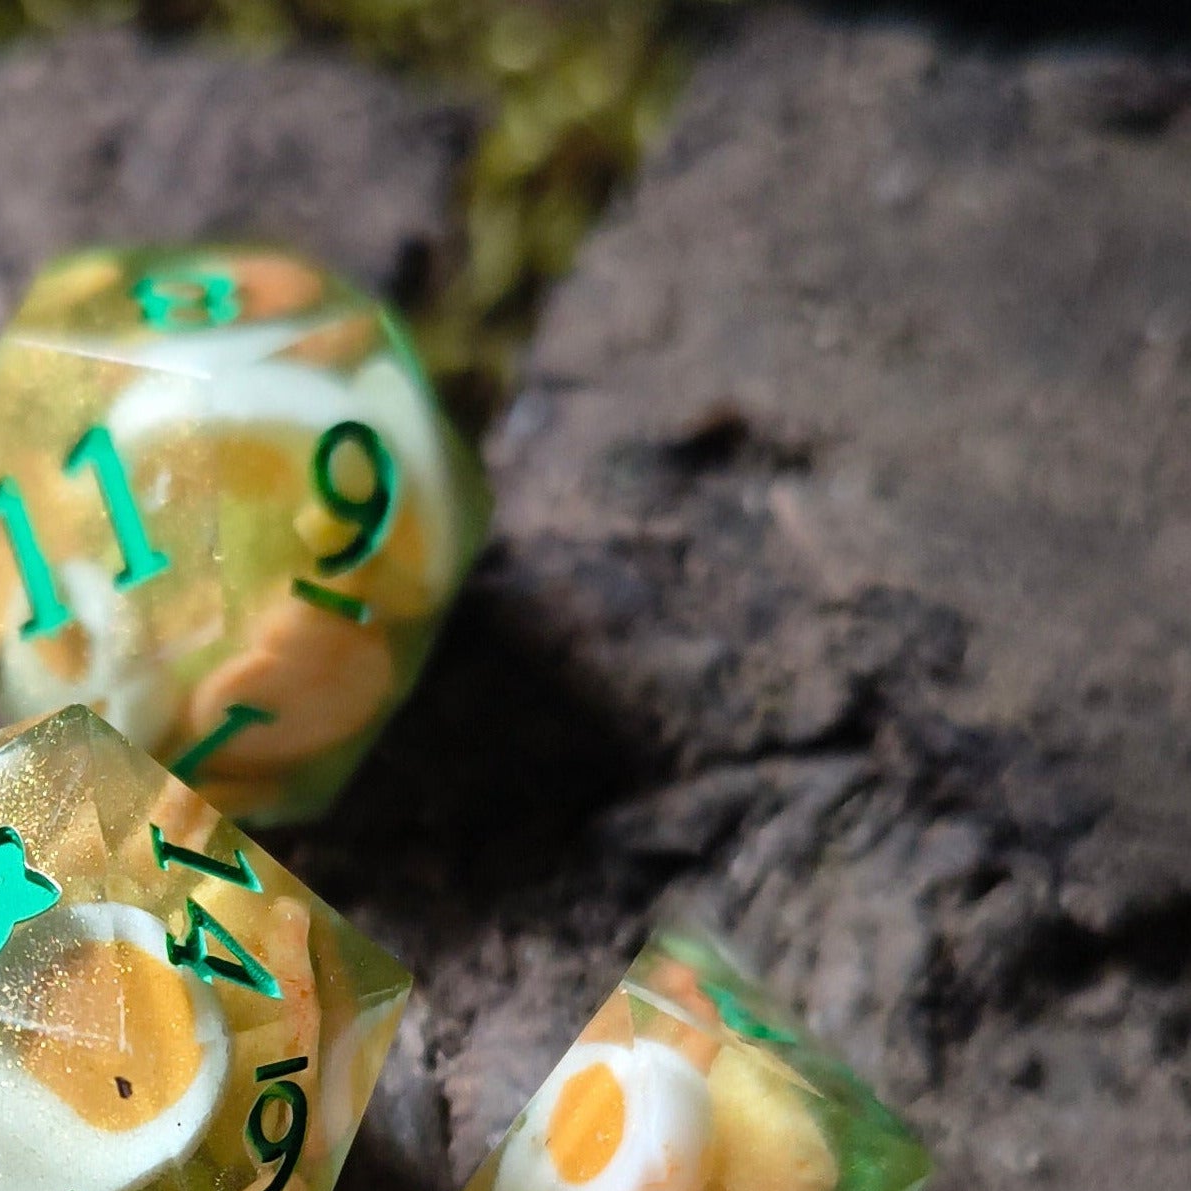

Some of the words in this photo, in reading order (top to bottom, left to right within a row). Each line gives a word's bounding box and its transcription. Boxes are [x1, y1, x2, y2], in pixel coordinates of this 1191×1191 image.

[133, 271, 239, 331] 8
[291, 418, 397, 624] 9
[149, 823, 285, 1001] 14
